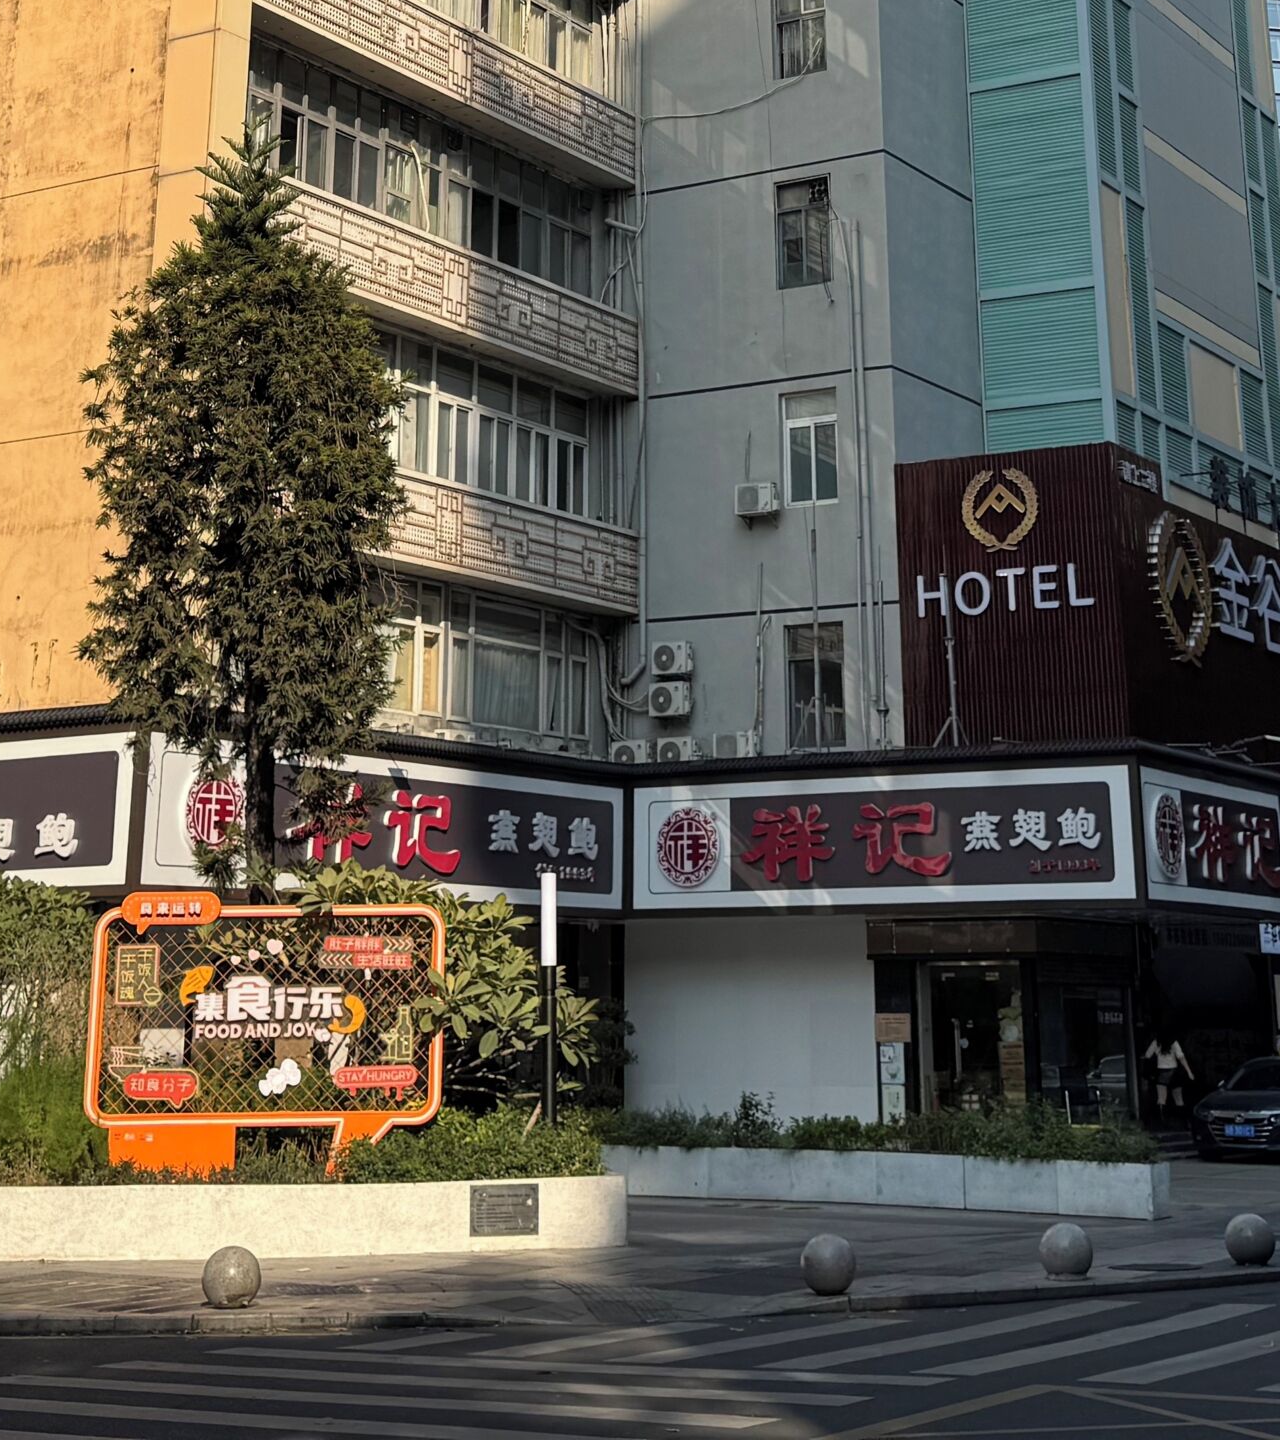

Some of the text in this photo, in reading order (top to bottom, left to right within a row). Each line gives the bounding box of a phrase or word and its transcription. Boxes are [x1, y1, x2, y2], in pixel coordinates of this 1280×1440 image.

[917, 563, 1095, 618] HOTEL
[488, 808, 599, 861] 燕翅鲍
[740, 801, 1103, 882] 祥记 燕翅鲍
[329, 937, 380, 951] 肚子胖胖
[357, 955, 408, 967] 生活旺旺
[120, 954, 137, 1000] 干饭魂
[137, 948, 152, 991] 干饭人
[194, 975, 344, 1022] 集食行乐
[194, 1022, 316, 1040] FOOD AND JOY
[338, 1069, 413, 1084] STAY HUNGRY
